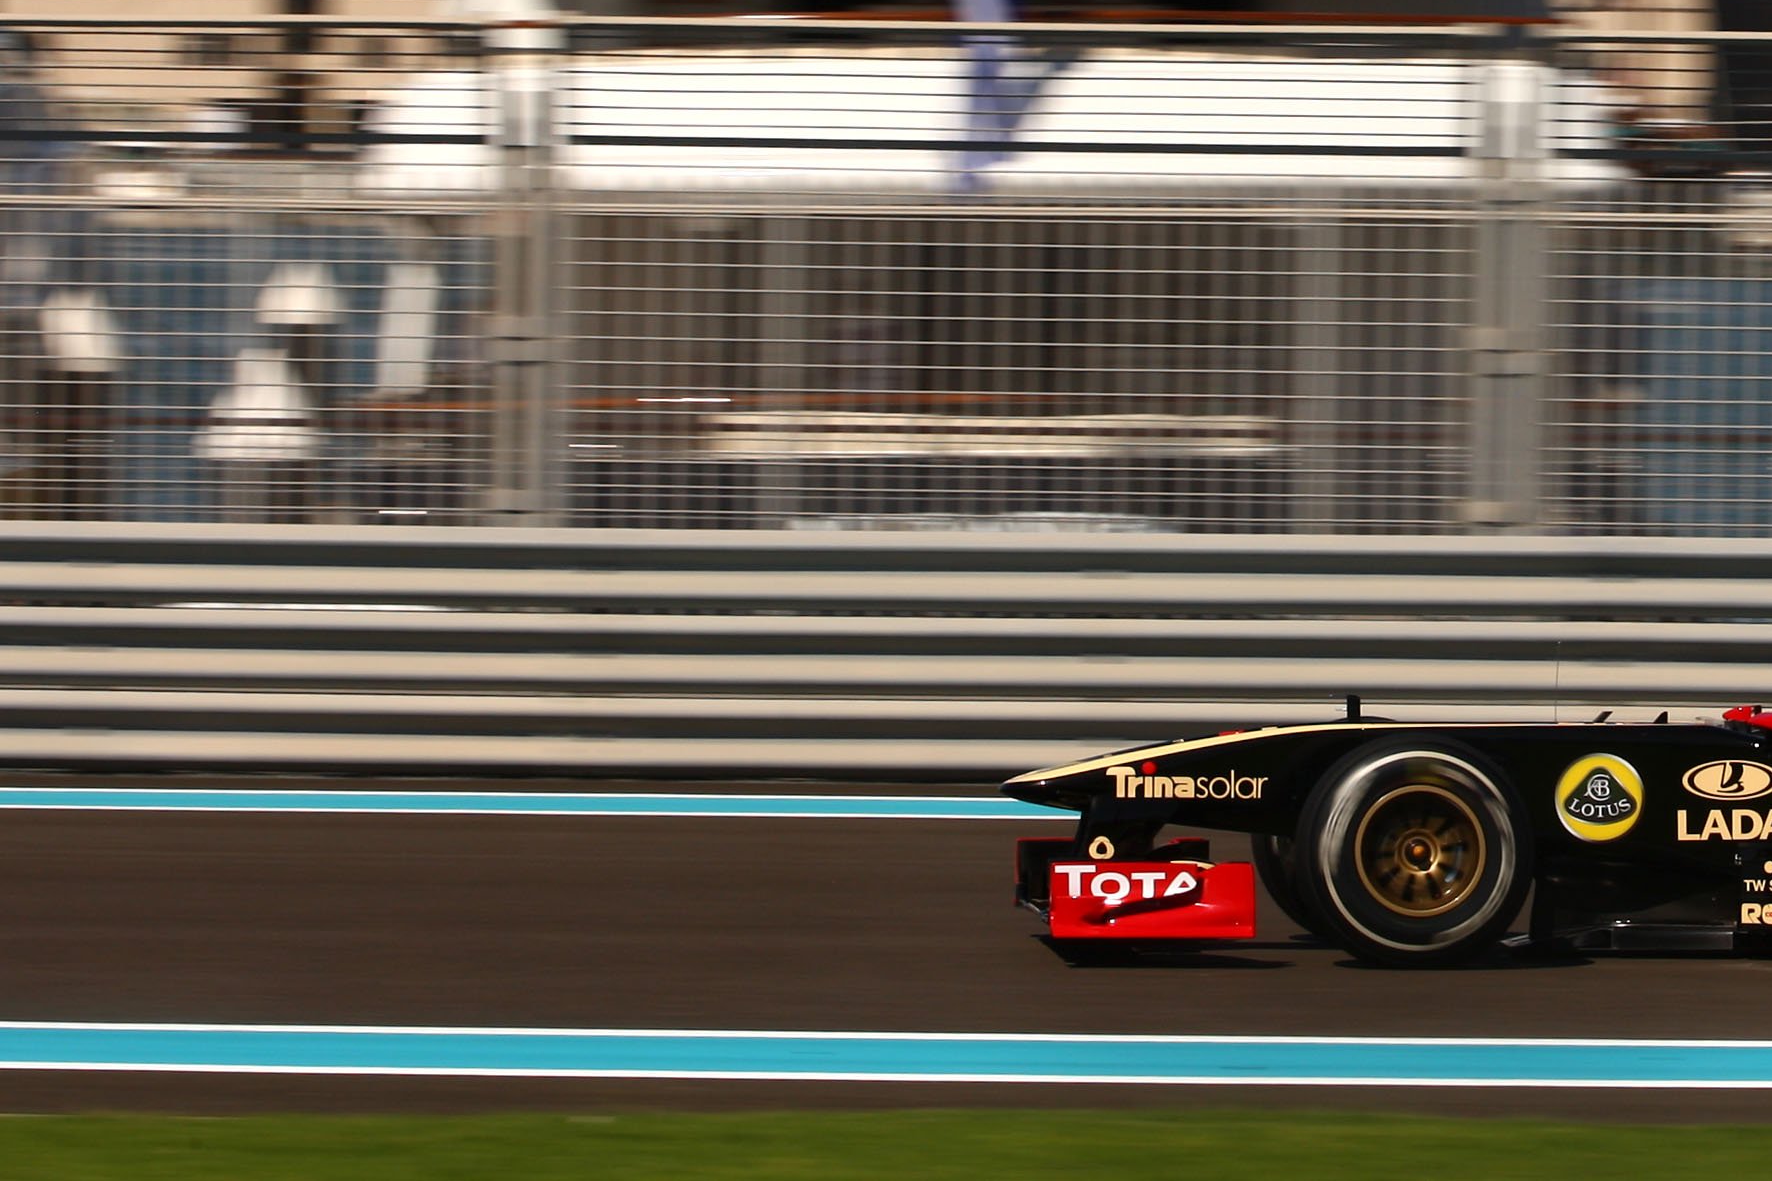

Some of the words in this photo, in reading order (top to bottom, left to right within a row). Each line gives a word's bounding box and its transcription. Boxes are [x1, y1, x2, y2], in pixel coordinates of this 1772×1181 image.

[1568, 797, 1632, 818] LOTUS
[1054, 864, 1198, 901] TOTA
[1743, 879, 1766, 892] TW
